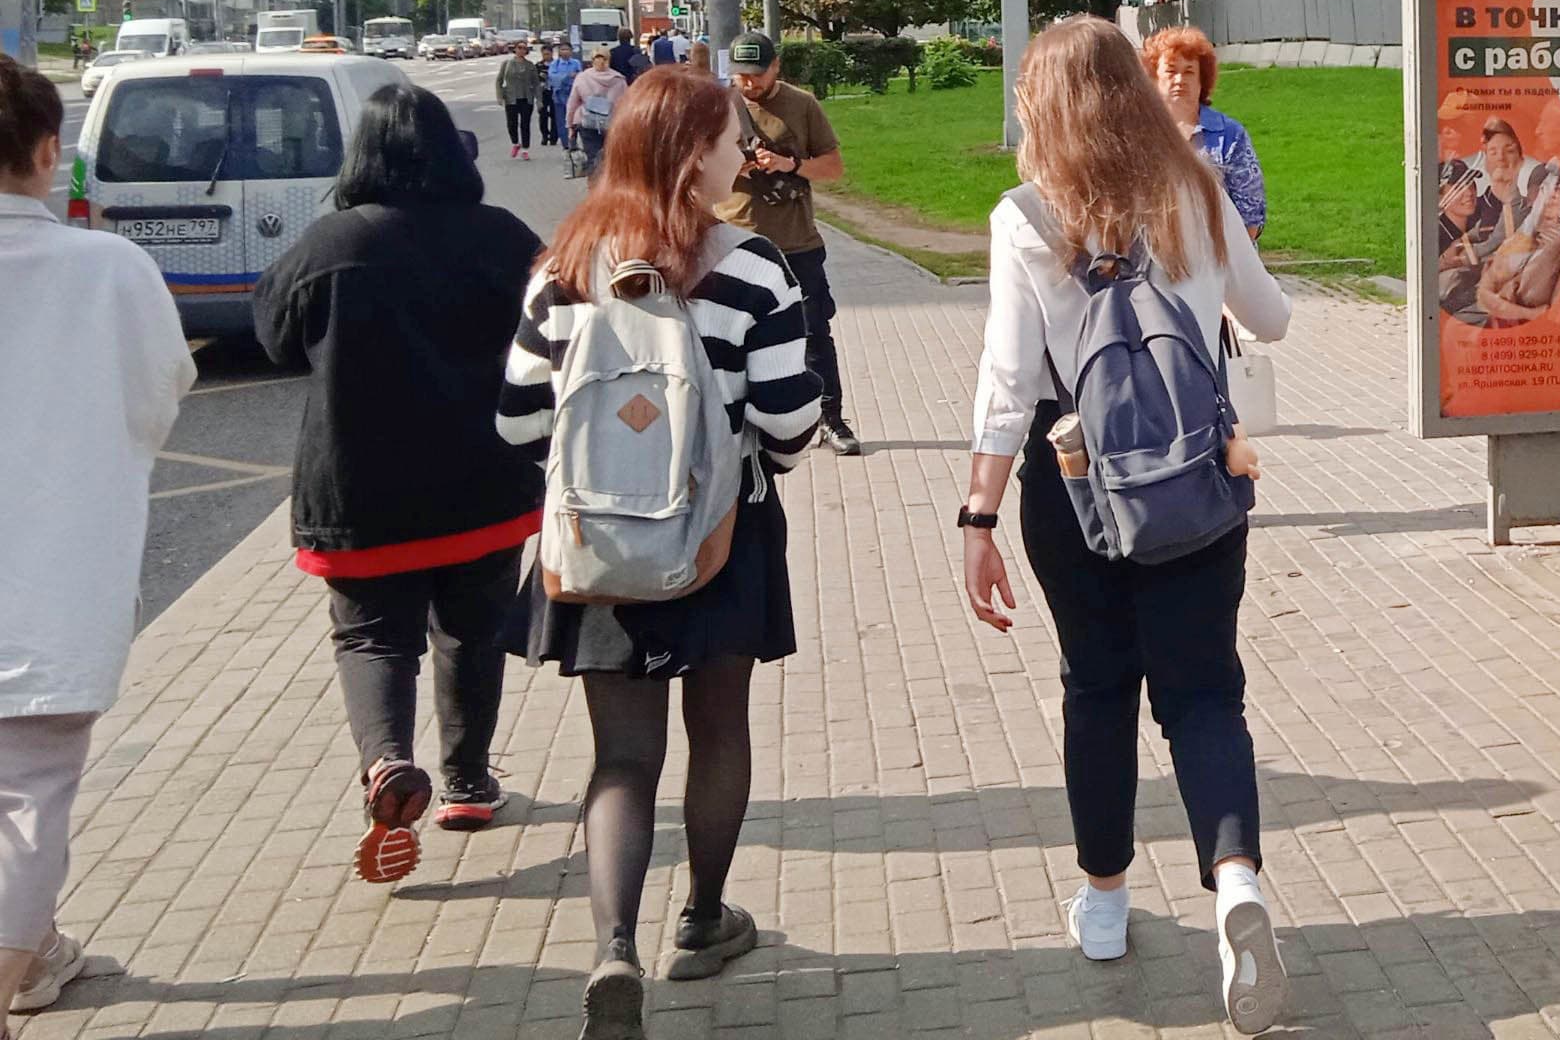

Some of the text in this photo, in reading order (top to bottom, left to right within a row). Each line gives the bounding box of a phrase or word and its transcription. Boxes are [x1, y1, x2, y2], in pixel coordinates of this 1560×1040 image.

[1456, 7, 1476, 28] в
[1454, 47, 1475, 70] с
[1466, 88, 1496, 96] нами
[1498, 88, 1513, 96] ты
[122, 220, 216, 237] Н952НЕ 797
[1532, 376, 1544, 385] 19
